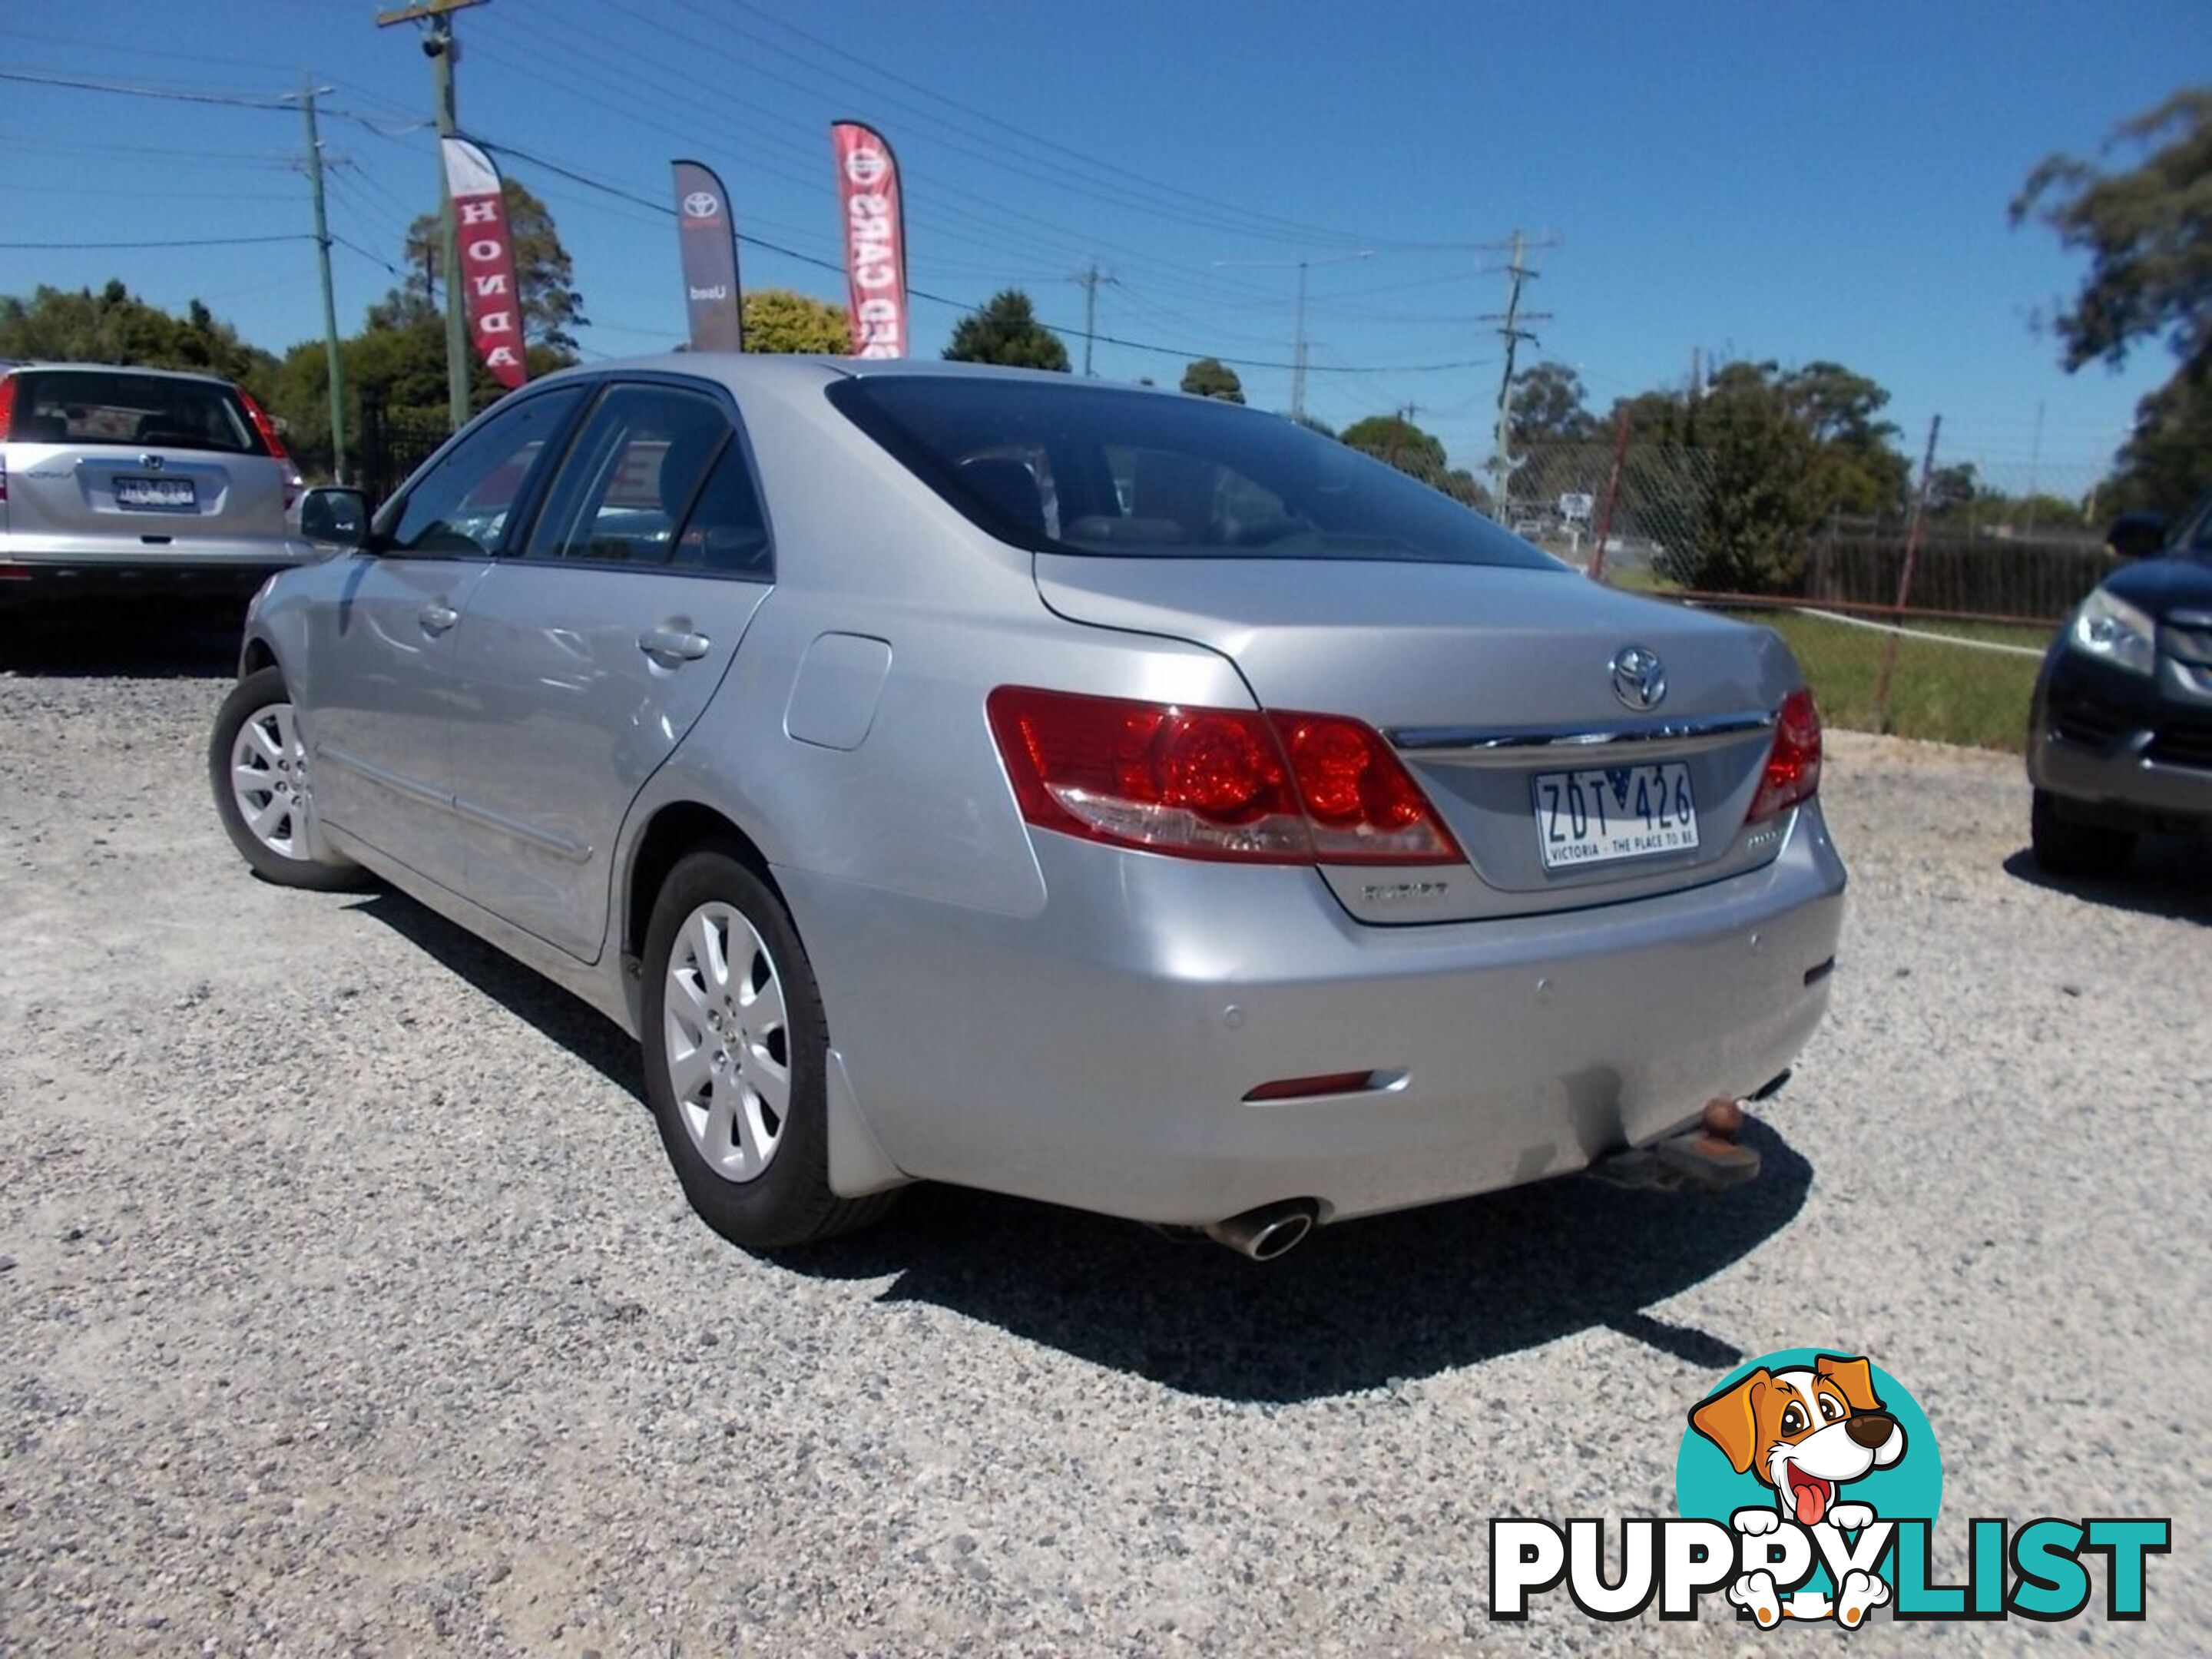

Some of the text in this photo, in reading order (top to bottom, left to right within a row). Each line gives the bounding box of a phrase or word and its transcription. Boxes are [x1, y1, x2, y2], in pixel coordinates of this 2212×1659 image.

[1634, 772, 1690, 830] 426
[1550, 843, 1599, 862] VICTORIA
[1612, 836, 1631, 853] THE
[1634, 833, 1662, 849] PLACE
[1665, 831, 1679, 846] TO
